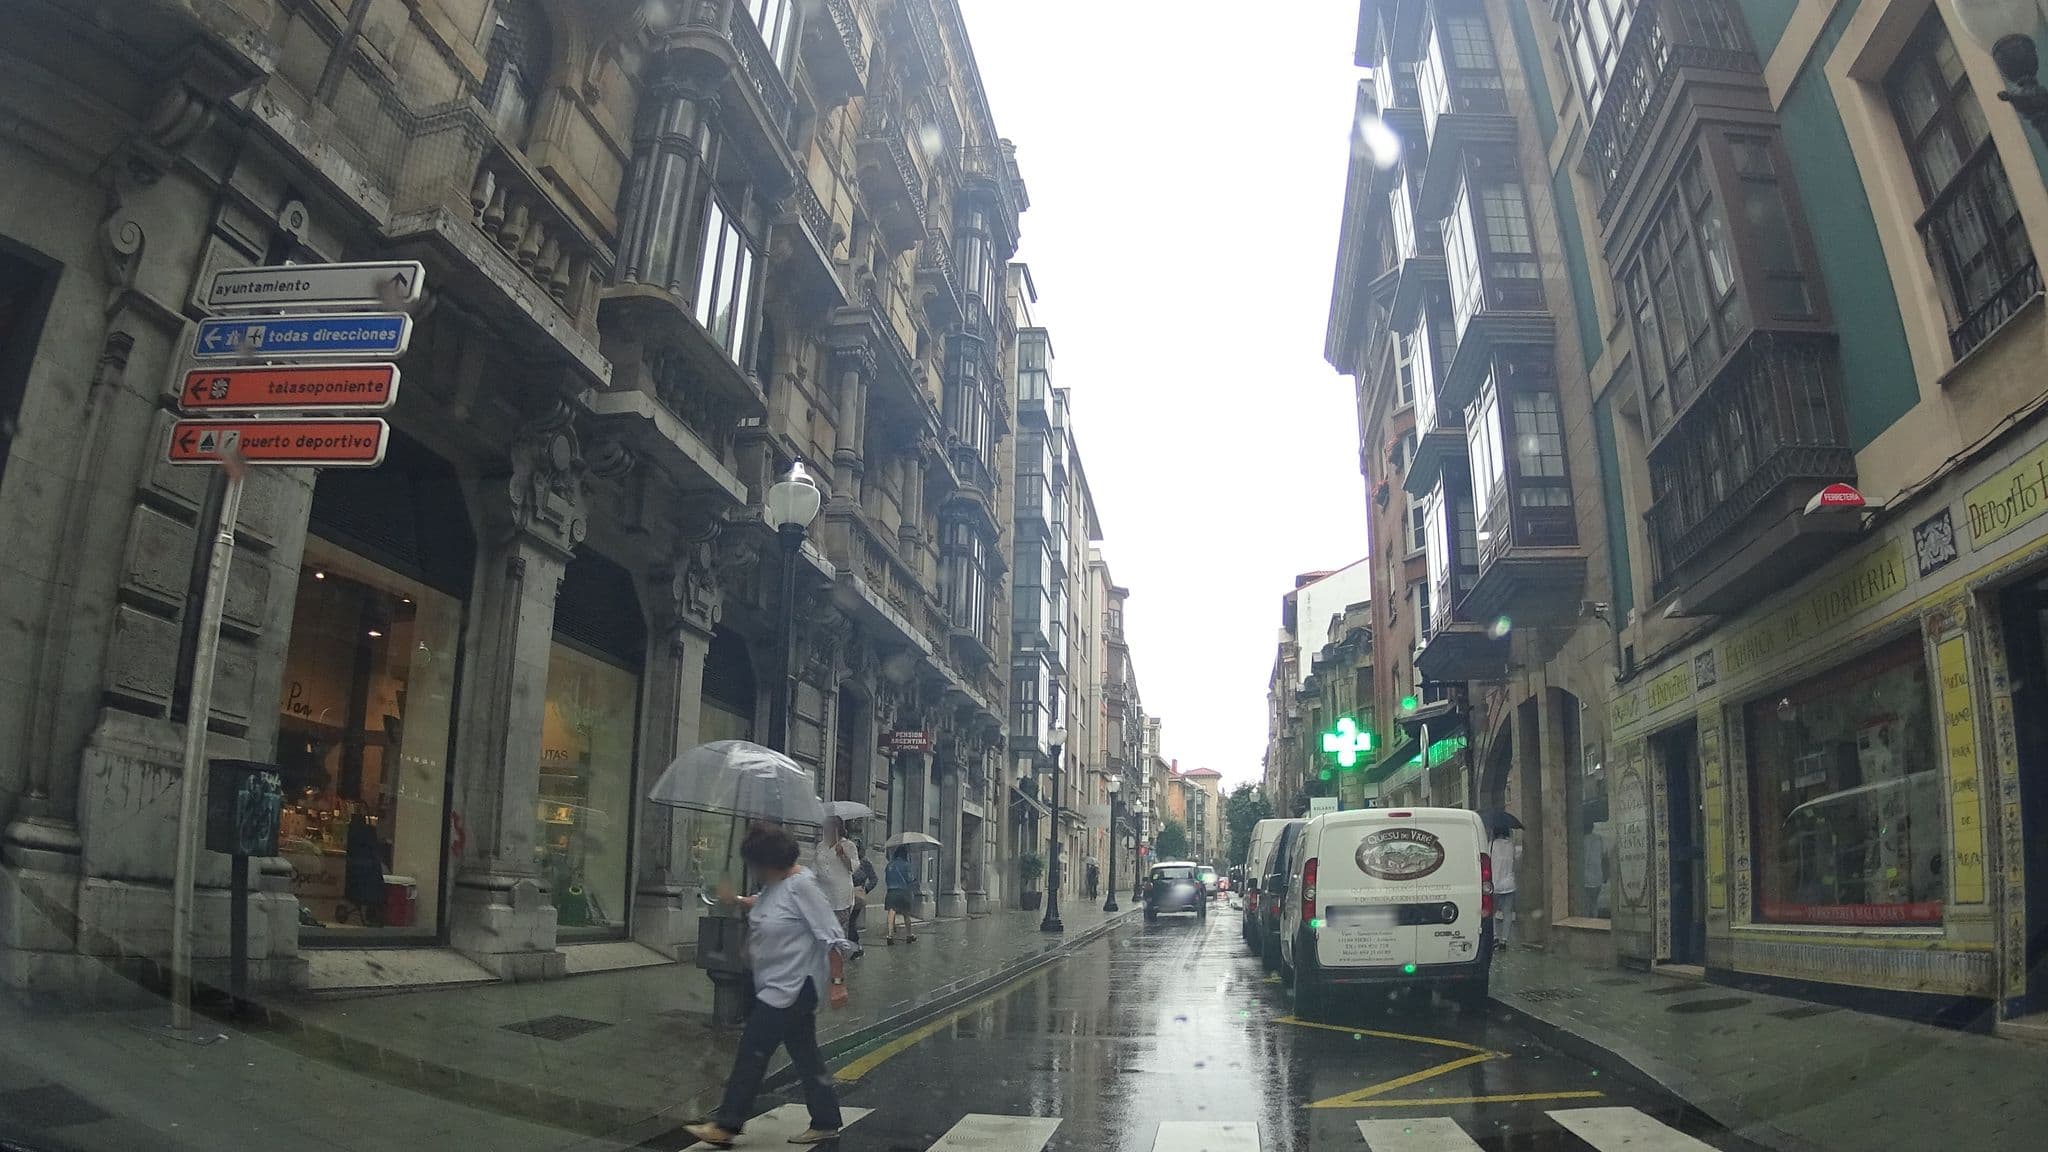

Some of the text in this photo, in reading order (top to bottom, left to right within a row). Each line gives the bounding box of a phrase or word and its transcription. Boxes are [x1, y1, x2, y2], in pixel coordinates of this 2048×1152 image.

[215, 278, 311, 297] ayuntamiento
[269, 326, 397, 343] todas direcciones
[267, 379, 385, 397] talasoponiente
[240, 431, 372, 450] puerto deportivo
[1367, 831, 1399, 845] QUESU
